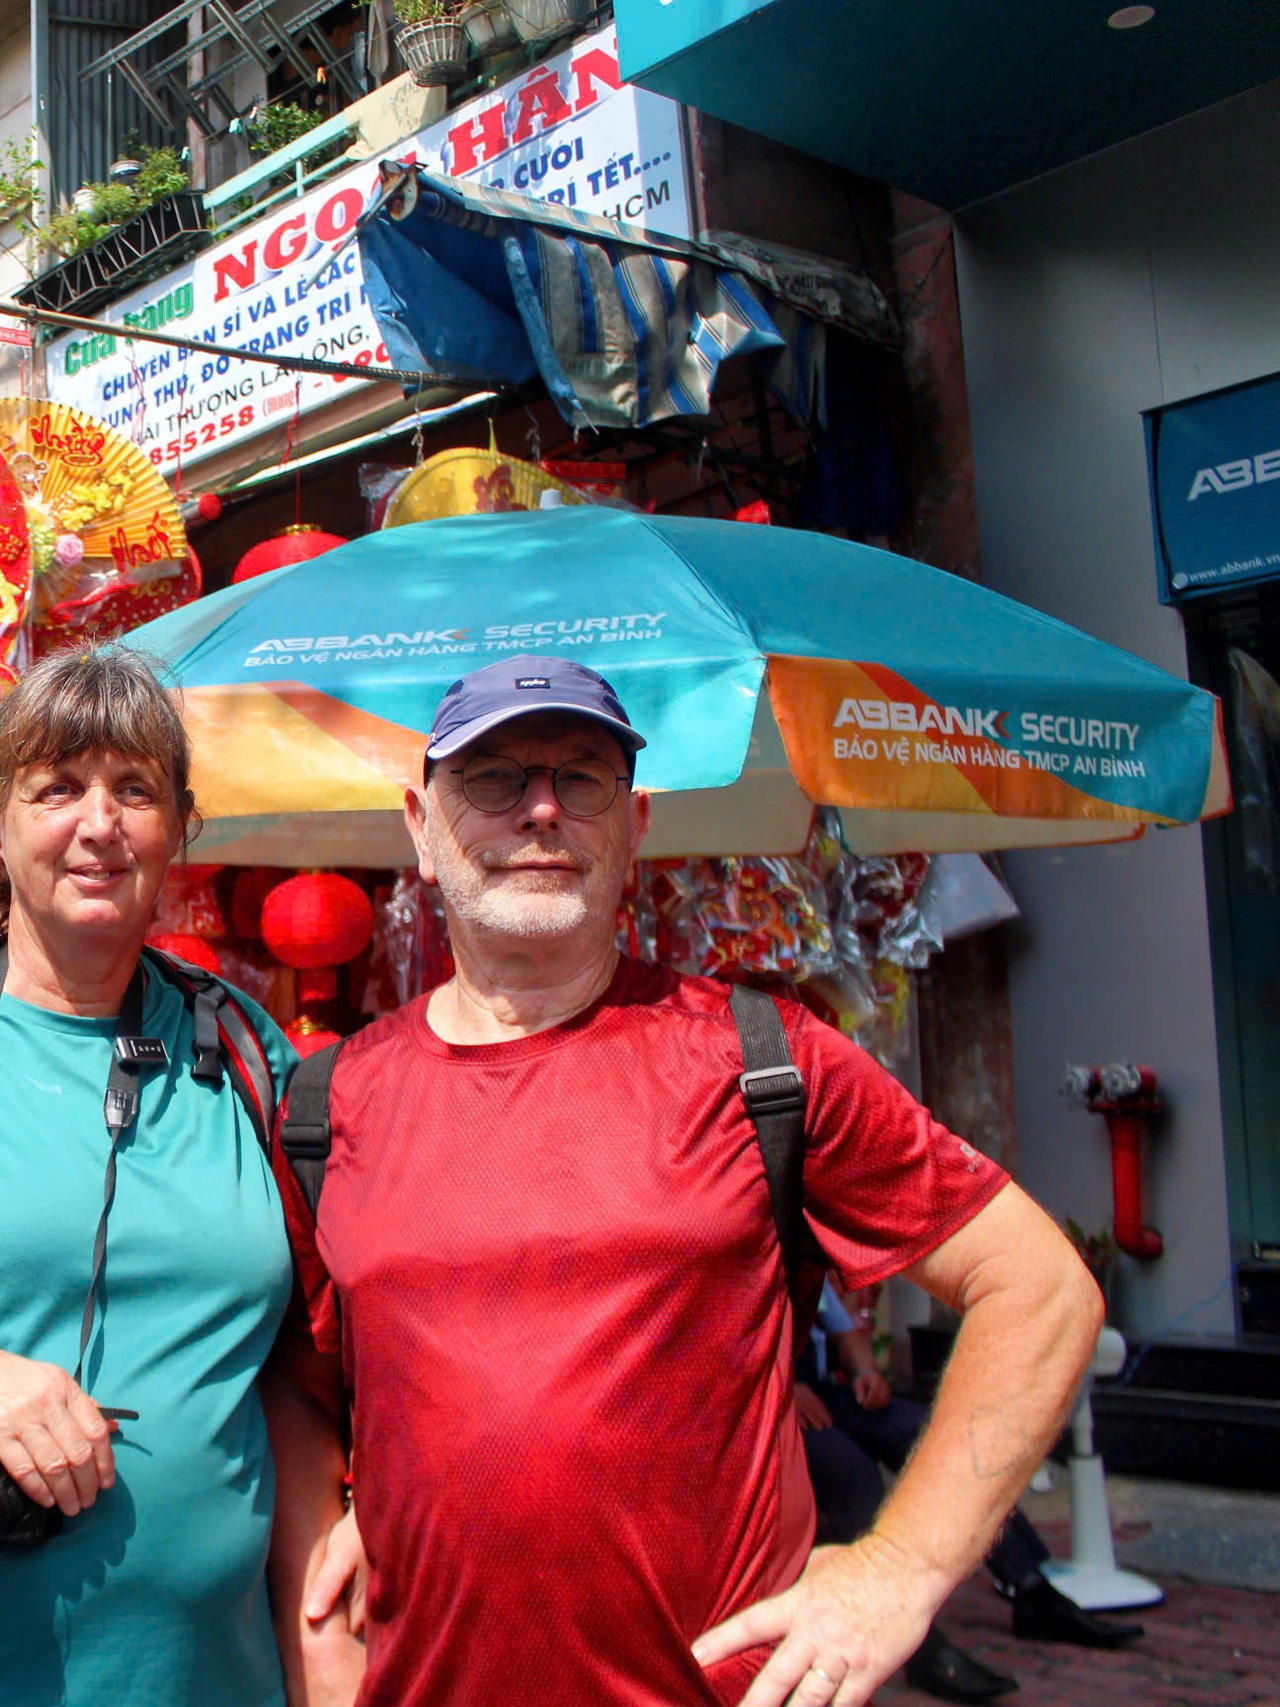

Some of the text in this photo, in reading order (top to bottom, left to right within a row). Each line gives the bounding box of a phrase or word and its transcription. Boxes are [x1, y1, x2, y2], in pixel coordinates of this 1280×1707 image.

[248, 291, 277, 324] VÀ
[514, 136, 584, 190] CƯỚI
[248, 612, 667, 654] ABBANK SECURITY
[482, 637, 553, 651] TMCP
[556, 632, 597, 646] AN
[833, 698, 1140, 751] ABBANK SECURITY
[833, 735, 1147, 778] BẢO VỆ NGÂN HÀNG TMCP AN BÌNH
